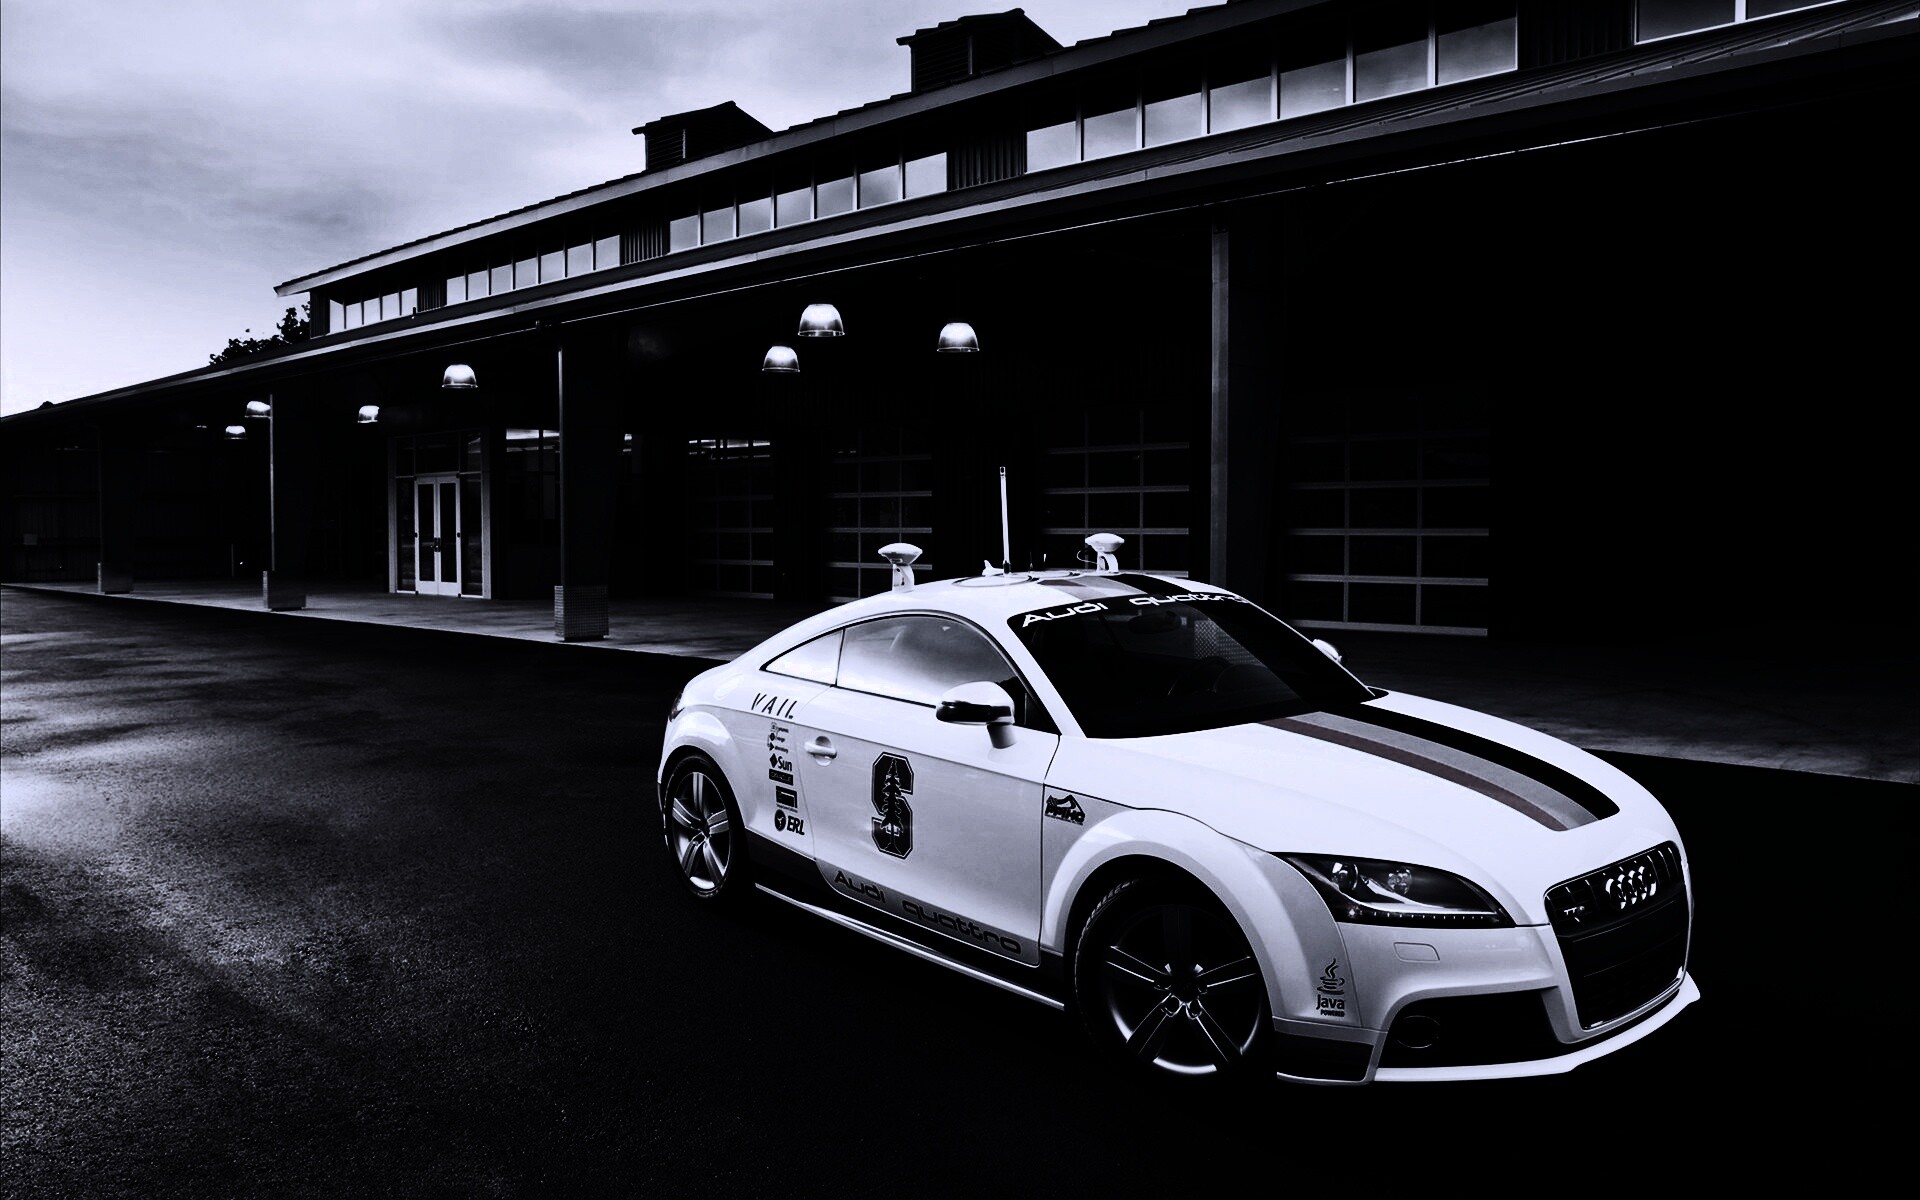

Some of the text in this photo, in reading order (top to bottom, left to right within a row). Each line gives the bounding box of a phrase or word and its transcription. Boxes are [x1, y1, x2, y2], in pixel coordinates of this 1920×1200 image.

[1022, 602, 1108, 627] Audi
[751, 693, 797, 719] VAIL
[777, 756, 792, 772] Sun
[787, 815, 805, 835] ERL
[834, 870, 1022, 954] Audi quattro
[1316, 994, 1345, 1010] Java
